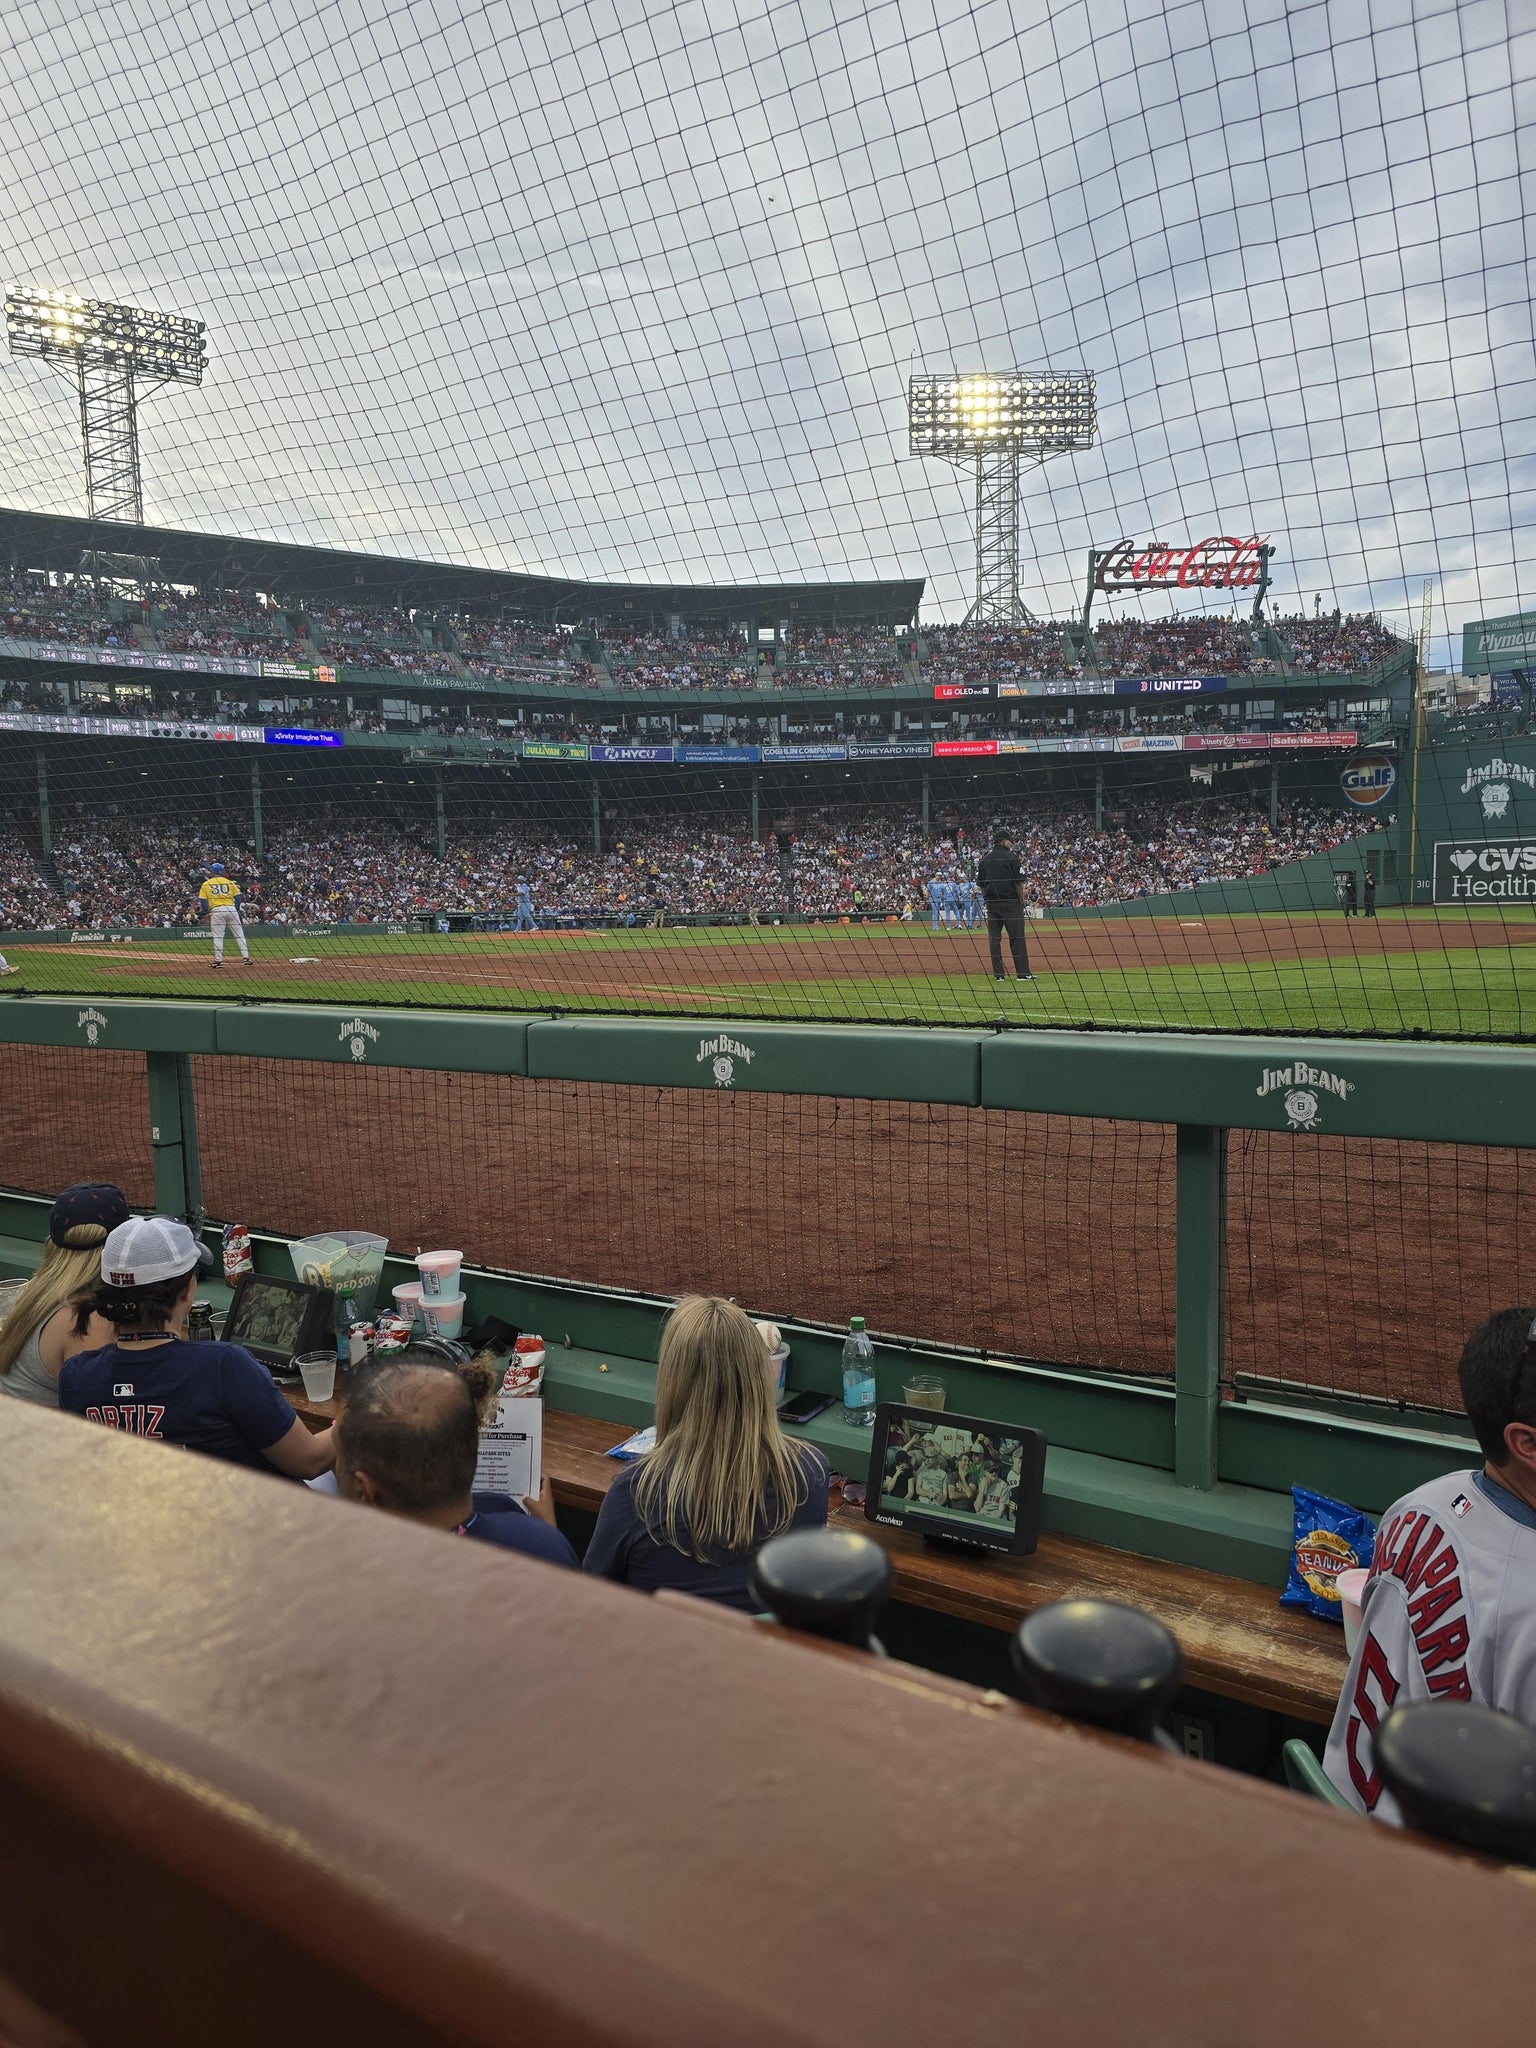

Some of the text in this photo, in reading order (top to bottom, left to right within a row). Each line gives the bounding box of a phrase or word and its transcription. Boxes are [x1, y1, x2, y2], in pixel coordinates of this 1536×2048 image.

[1096, 535, 1270, 591] Coca-Cola
[1154, 680, 1202, 691] UNITED
[241, 730, 260, 739] 6TH
[1142, 740, 1175, 748] AMAZING
[1273, 736, 1314, 745] Safelite
[905, 746, 930, 754] VINES
[1342, 768, 1392, 788] Gulf
[1461, 758, 1536, 794] JIM BEAM
[1478, 847, 1536, 872] CVS
[210, 883, 230, 895] 30
[1416, 880, 1431, 889] 310
[1452, 873, 1536, 897] Health
[308, 929, 332, 937] TICKET
[338, 1017, 377, 1044] JIM BEAM
[696, 1034, 751, 1065] JIM BEAM
[1256, 1061, 1348, 1101] JIM BEAM
[335, 1273, 379, 1294] RED SOX
[86, 1404, 165, 1439] ORTIZ
[498, 1432, 523, 1441] Purchase
